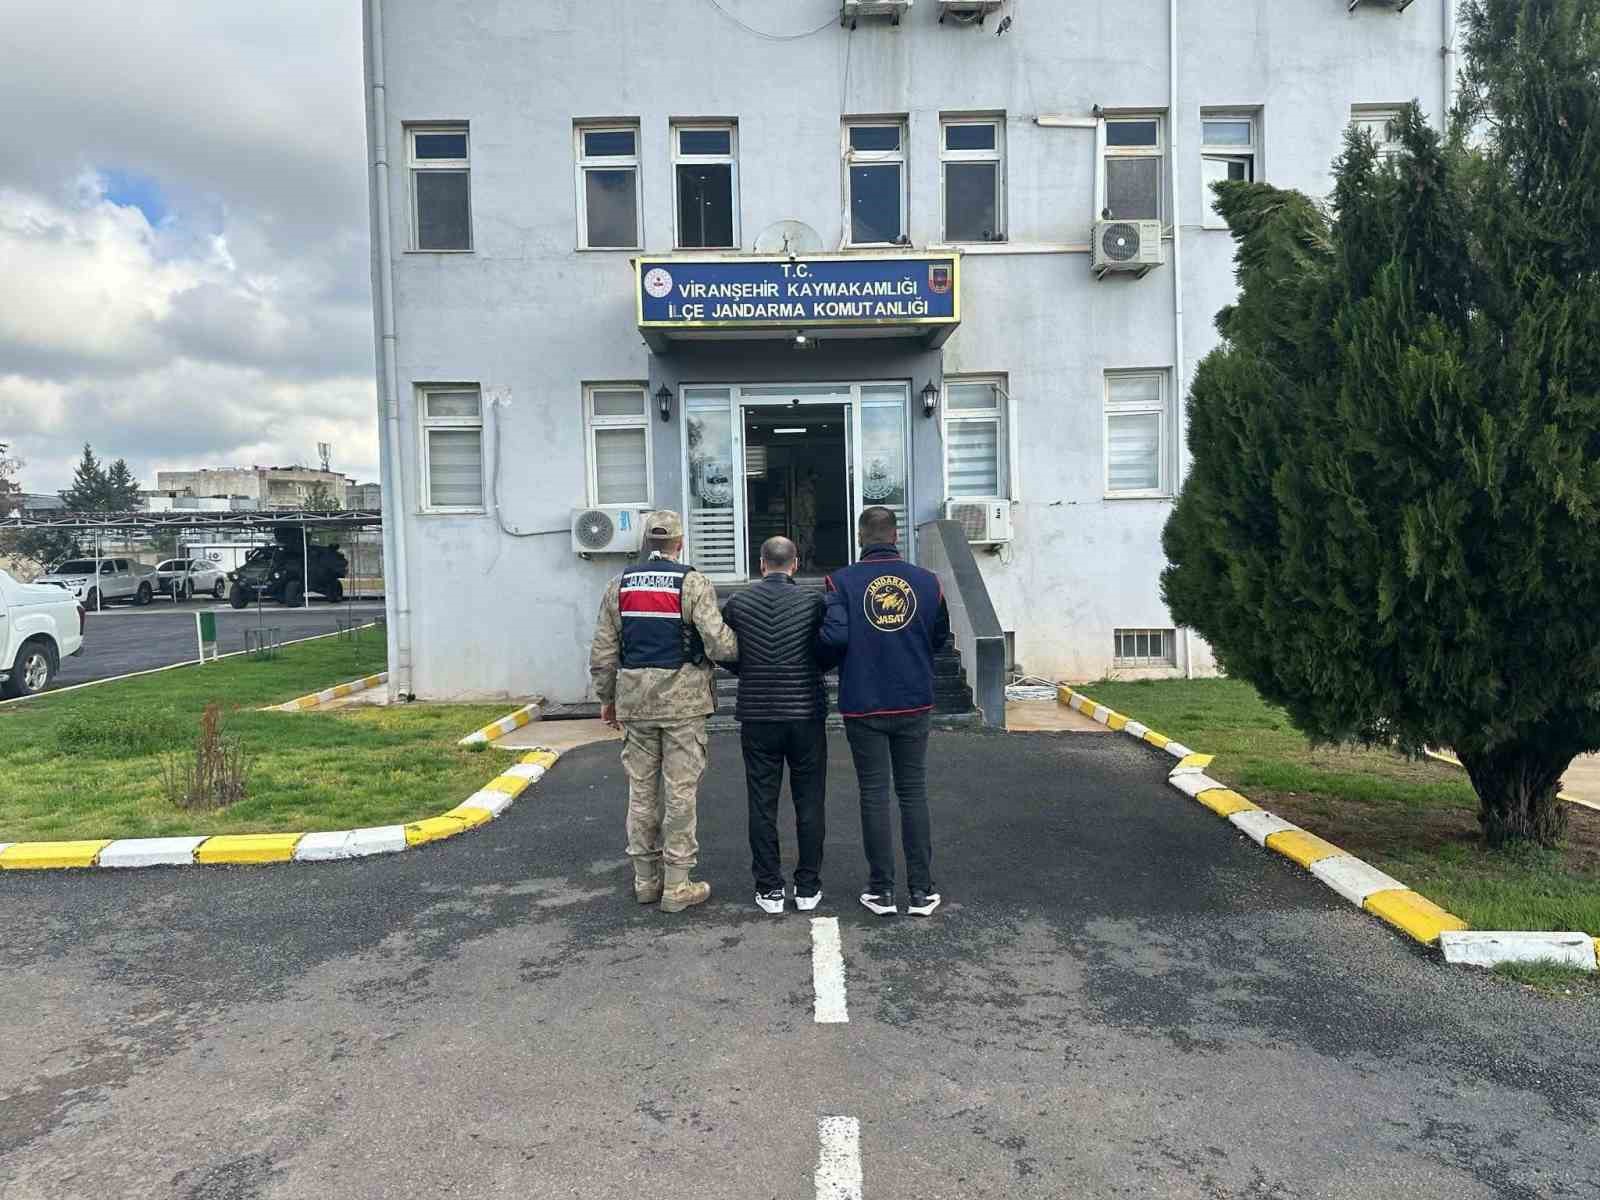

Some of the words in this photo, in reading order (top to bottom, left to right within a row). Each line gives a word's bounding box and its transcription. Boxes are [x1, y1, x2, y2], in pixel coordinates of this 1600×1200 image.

[781, 263, 813, 278] T.C.
[678, 280, 779, 301] VİRANŞEHİR
[787, 276, 918, 297] KAYMAKAMLIĞI
[668, 301, 705, 320] İLÇE
[712, 303, 806, 318] JANDARMA
[813, 296, 929, 317] KOMUTANLIĞI
[625, 575, 674, 588] JANDARMA
[869, 576, 911, 595] JANDARMA
[876, 614, 906, 625] JASAT
